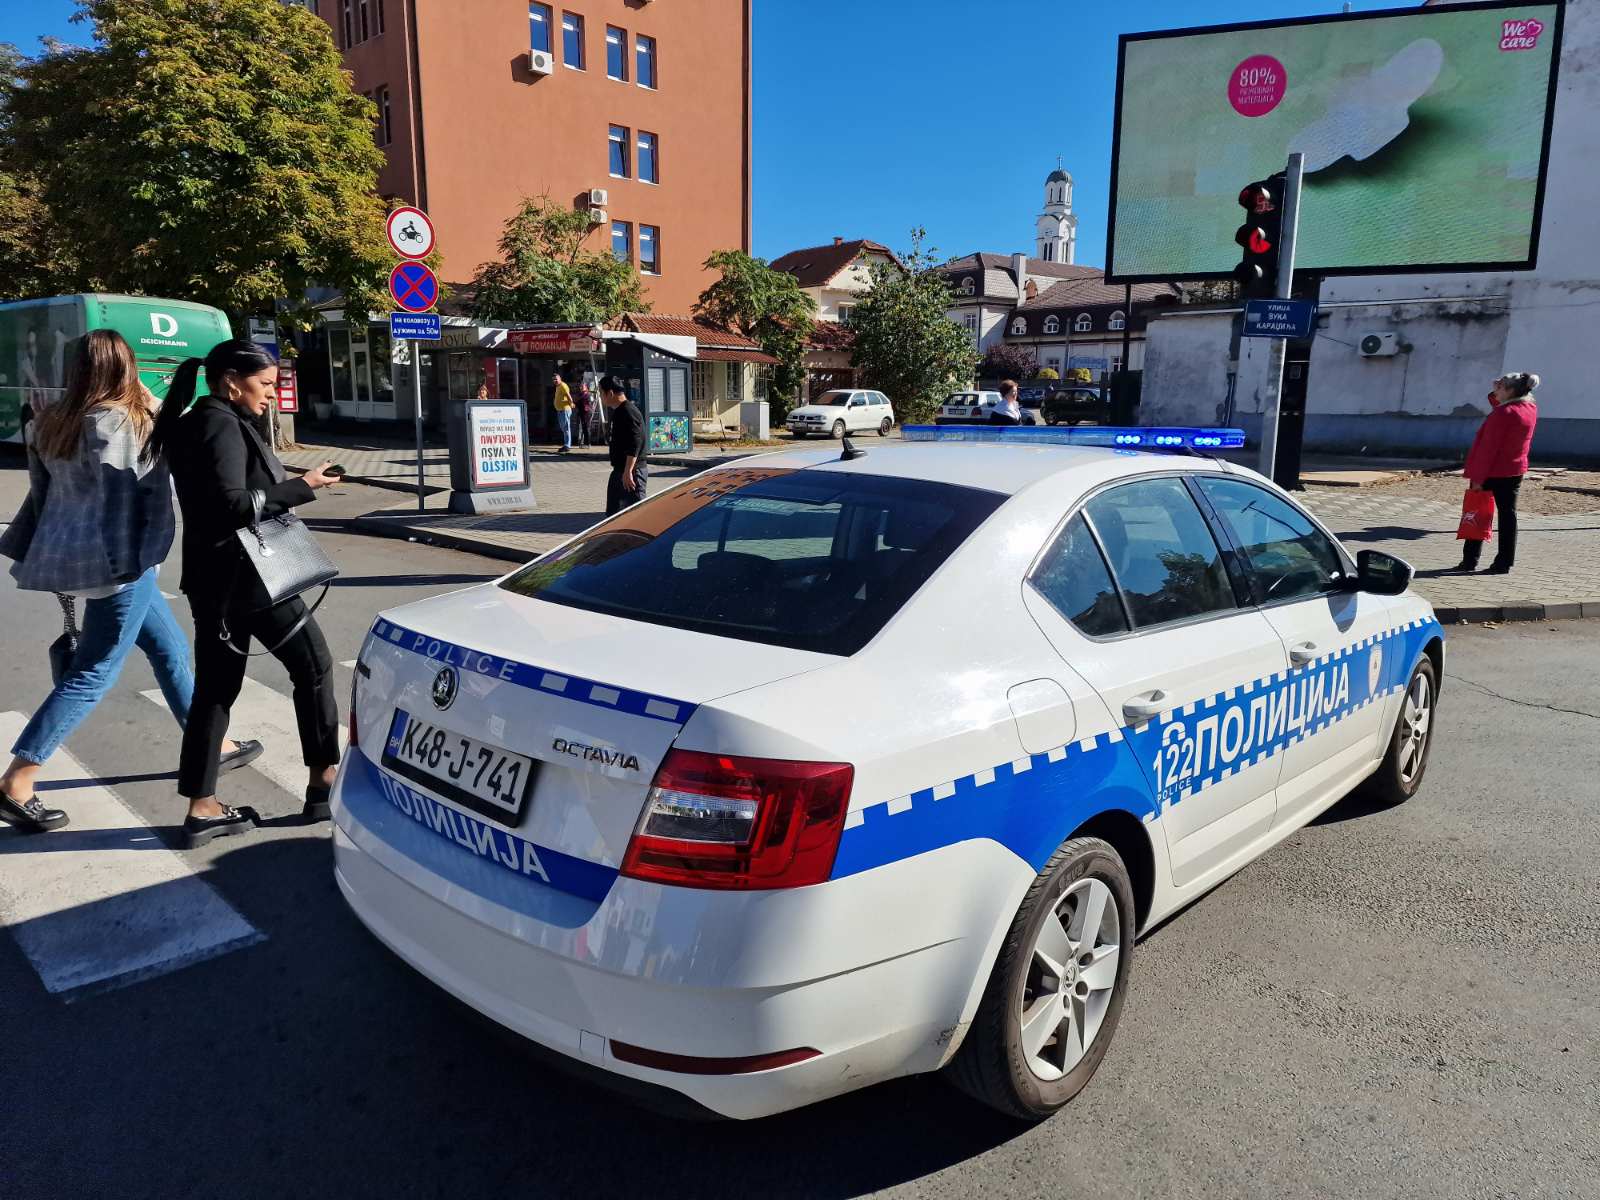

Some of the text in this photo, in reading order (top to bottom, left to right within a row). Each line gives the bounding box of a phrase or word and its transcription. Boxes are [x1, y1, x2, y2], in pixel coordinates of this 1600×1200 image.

[1504, 22, 1526, 37] We
[1500, 36, 1535, 49] care
[1239, 67, 1276, 87] 80%
[1267, 304, 1291, 312] УЛИЦА
[140, 337, 188, 347] DEICHMANN
[530, 341, 567, 351] ROMANIJA
[480, 434, 516, 445] REKLAMU
[481, 446, 517, 460] ZA VAŠU
[482, 460, 517, 472] MJESTO
[412, 635, 518, 681] POLICE
[1192, 662, 1349, 777] ПОЛИЦИЈА
[401, 718, 522, 805] K48-J-741
[552, 737, 640, 772] OCTAVIA
[1153, 738, 1194, 793] 122
[1157, 777, 1192, 806] POLICE
[378, 768, 551, 882] ПОЛИЦИЈА
